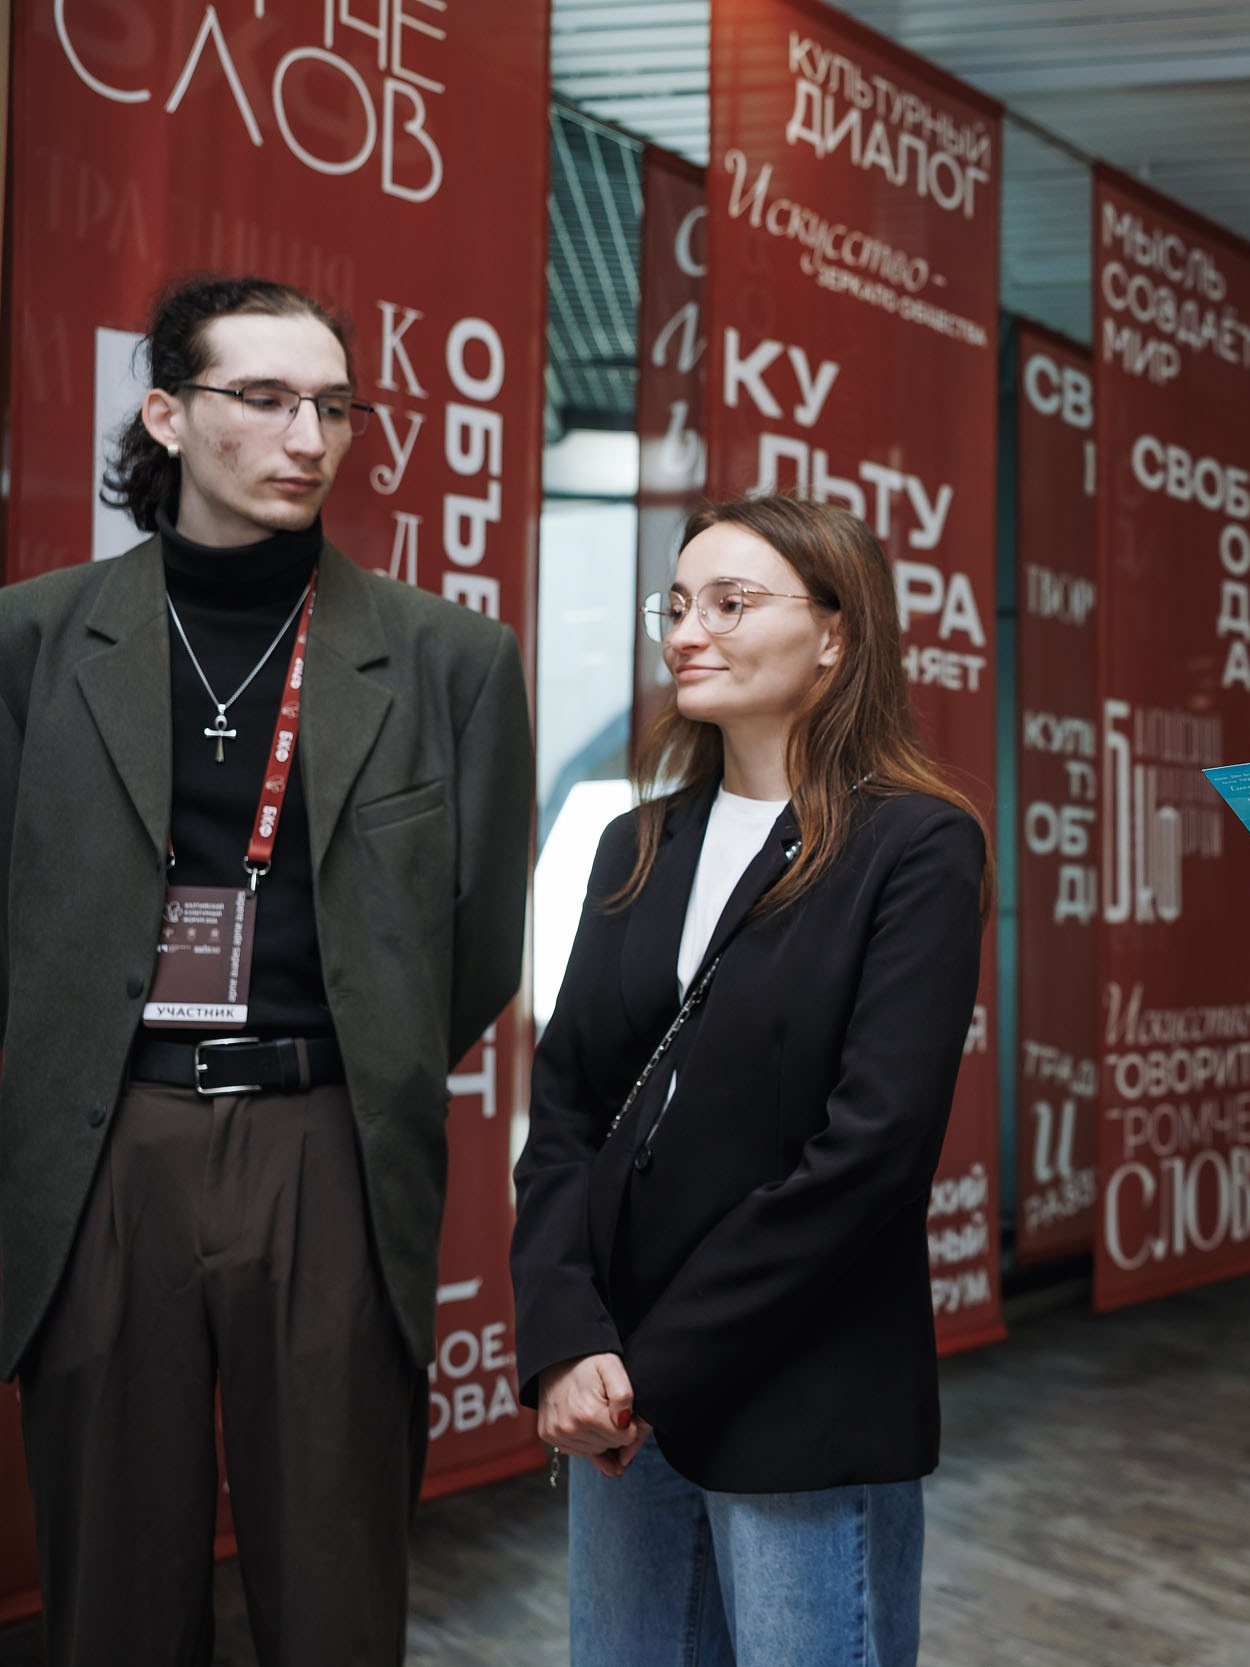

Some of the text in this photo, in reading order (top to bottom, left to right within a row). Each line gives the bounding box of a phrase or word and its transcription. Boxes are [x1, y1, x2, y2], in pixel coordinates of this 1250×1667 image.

[785, 77, 992, 221] ДИАЛОГ
[788, 30, 993, 167] КУЛЬТУРНЫЙ
[1103, 200, 1228, 303] МЫСЛЬ
[1103, 318, 1182, 386] МИР
[156, 1005, 235, 1019] УЧАСТНИК
